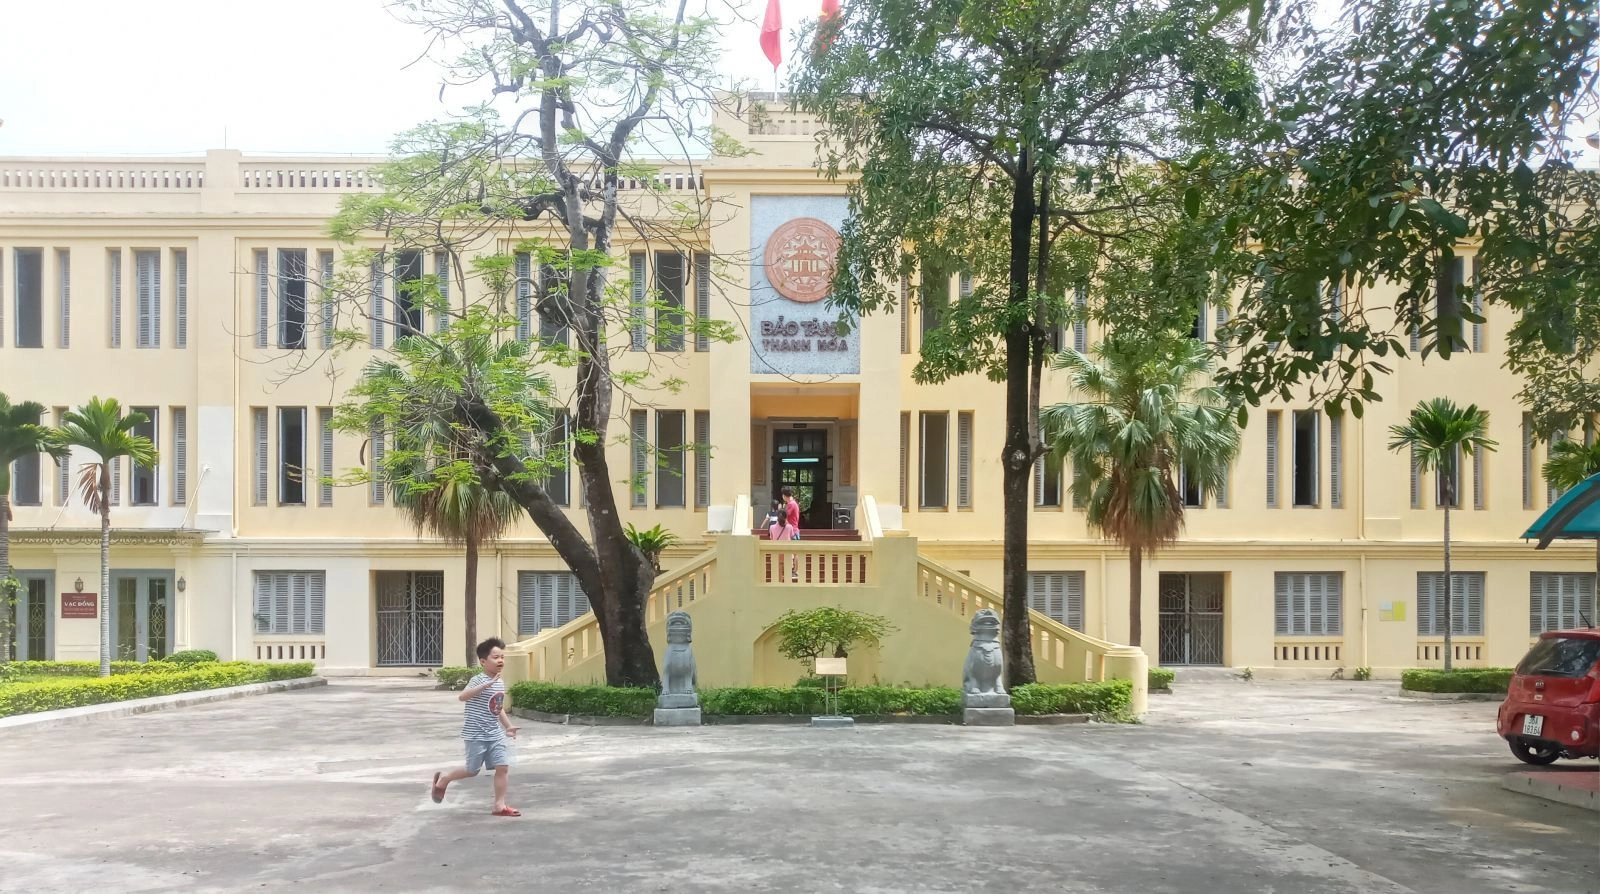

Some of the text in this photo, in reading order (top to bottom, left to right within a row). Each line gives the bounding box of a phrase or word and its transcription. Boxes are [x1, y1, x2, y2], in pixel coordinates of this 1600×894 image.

[760, 316, 849, 337] BẢO TÀN
[762, 337, 848, 351] THANH HÓA
